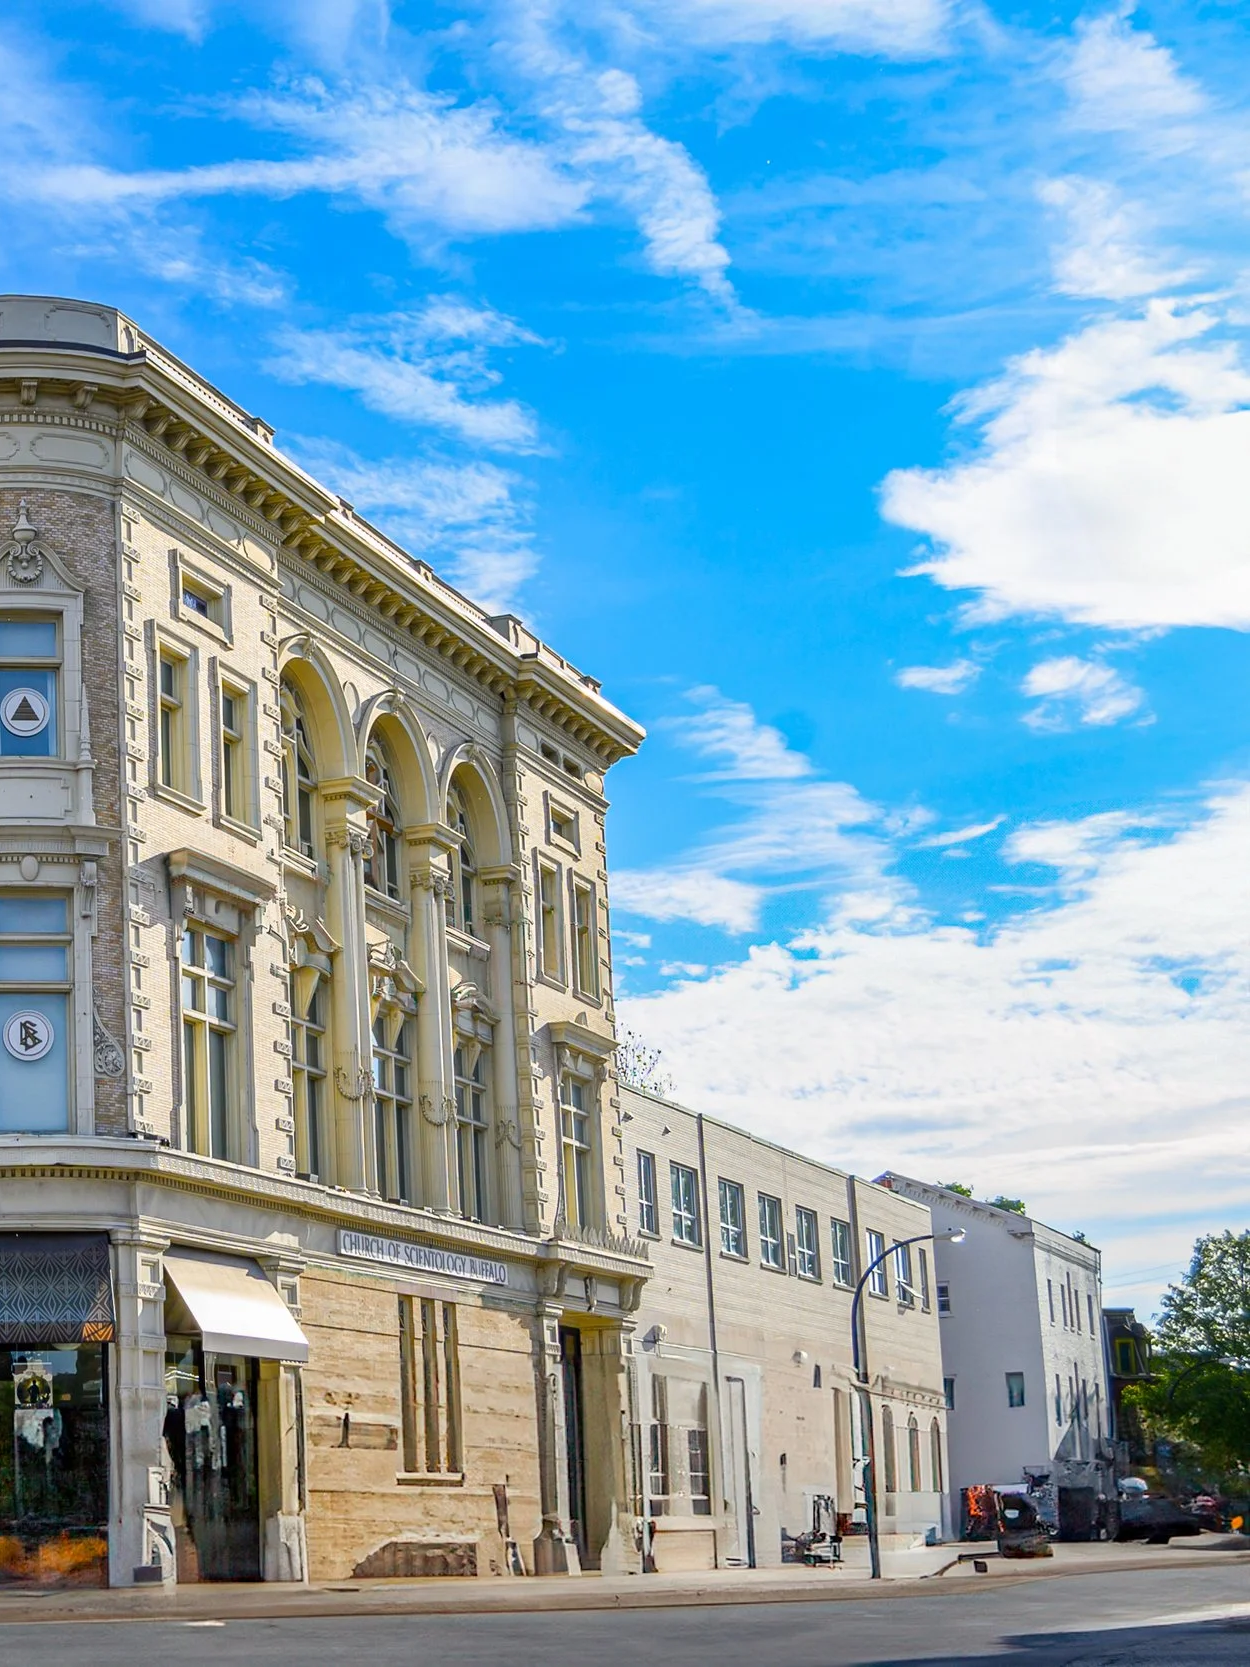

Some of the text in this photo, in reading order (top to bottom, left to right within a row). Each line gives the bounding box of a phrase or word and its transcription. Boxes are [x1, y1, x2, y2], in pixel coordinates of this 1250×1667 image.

[342, 1233, 507, 1283] CHURCH OF SCIENTOLOGY BUFFALO
